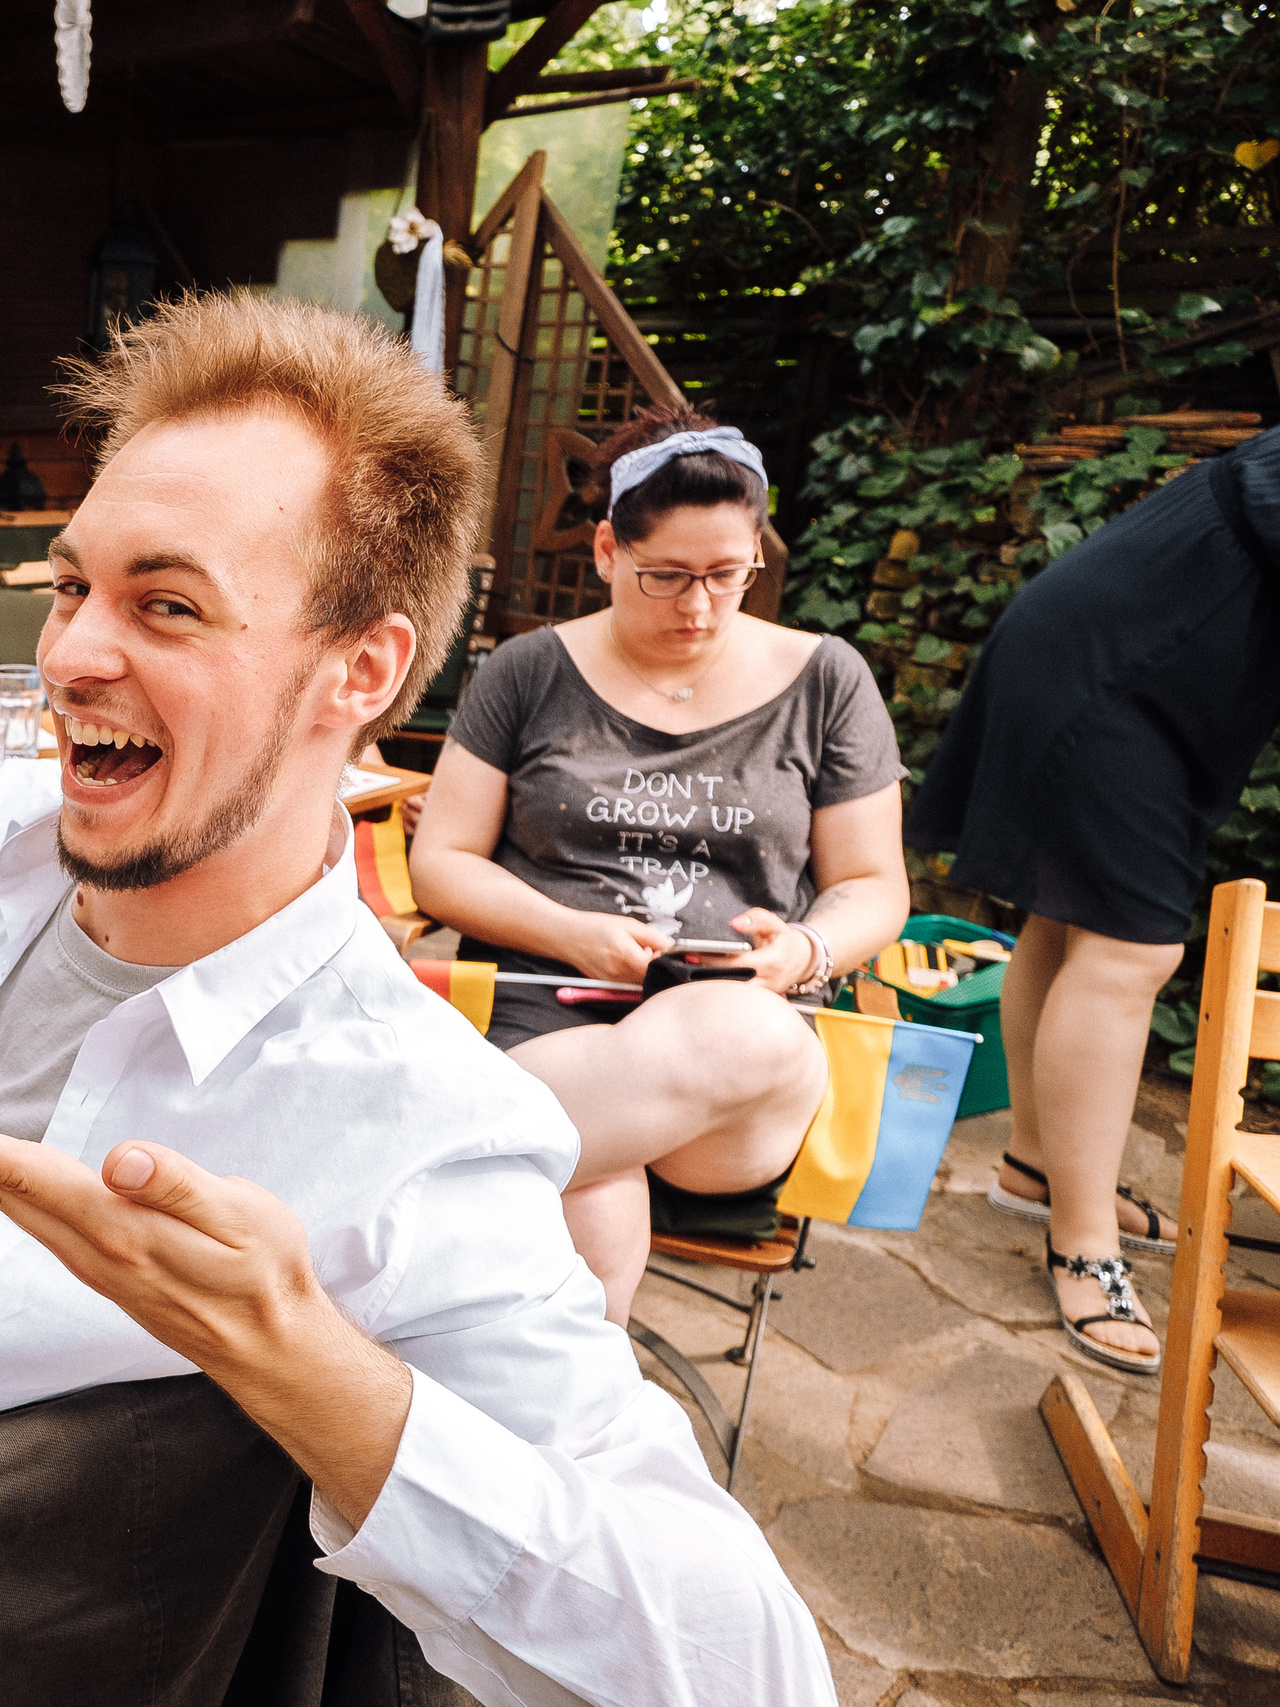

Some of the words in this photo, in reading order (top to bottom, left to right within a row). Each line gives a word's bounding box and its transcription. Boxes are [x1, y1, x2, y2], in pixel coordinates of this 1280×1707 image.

[623, 768, 723, 799] DON'T
[586, 796, 698, 828] GROW
[710, 806, 755, 834] UP
[617, 830, 678, 853] IT'S
[690, 839, 711, 859] A
[620, 856, 709, 884] TRAP
